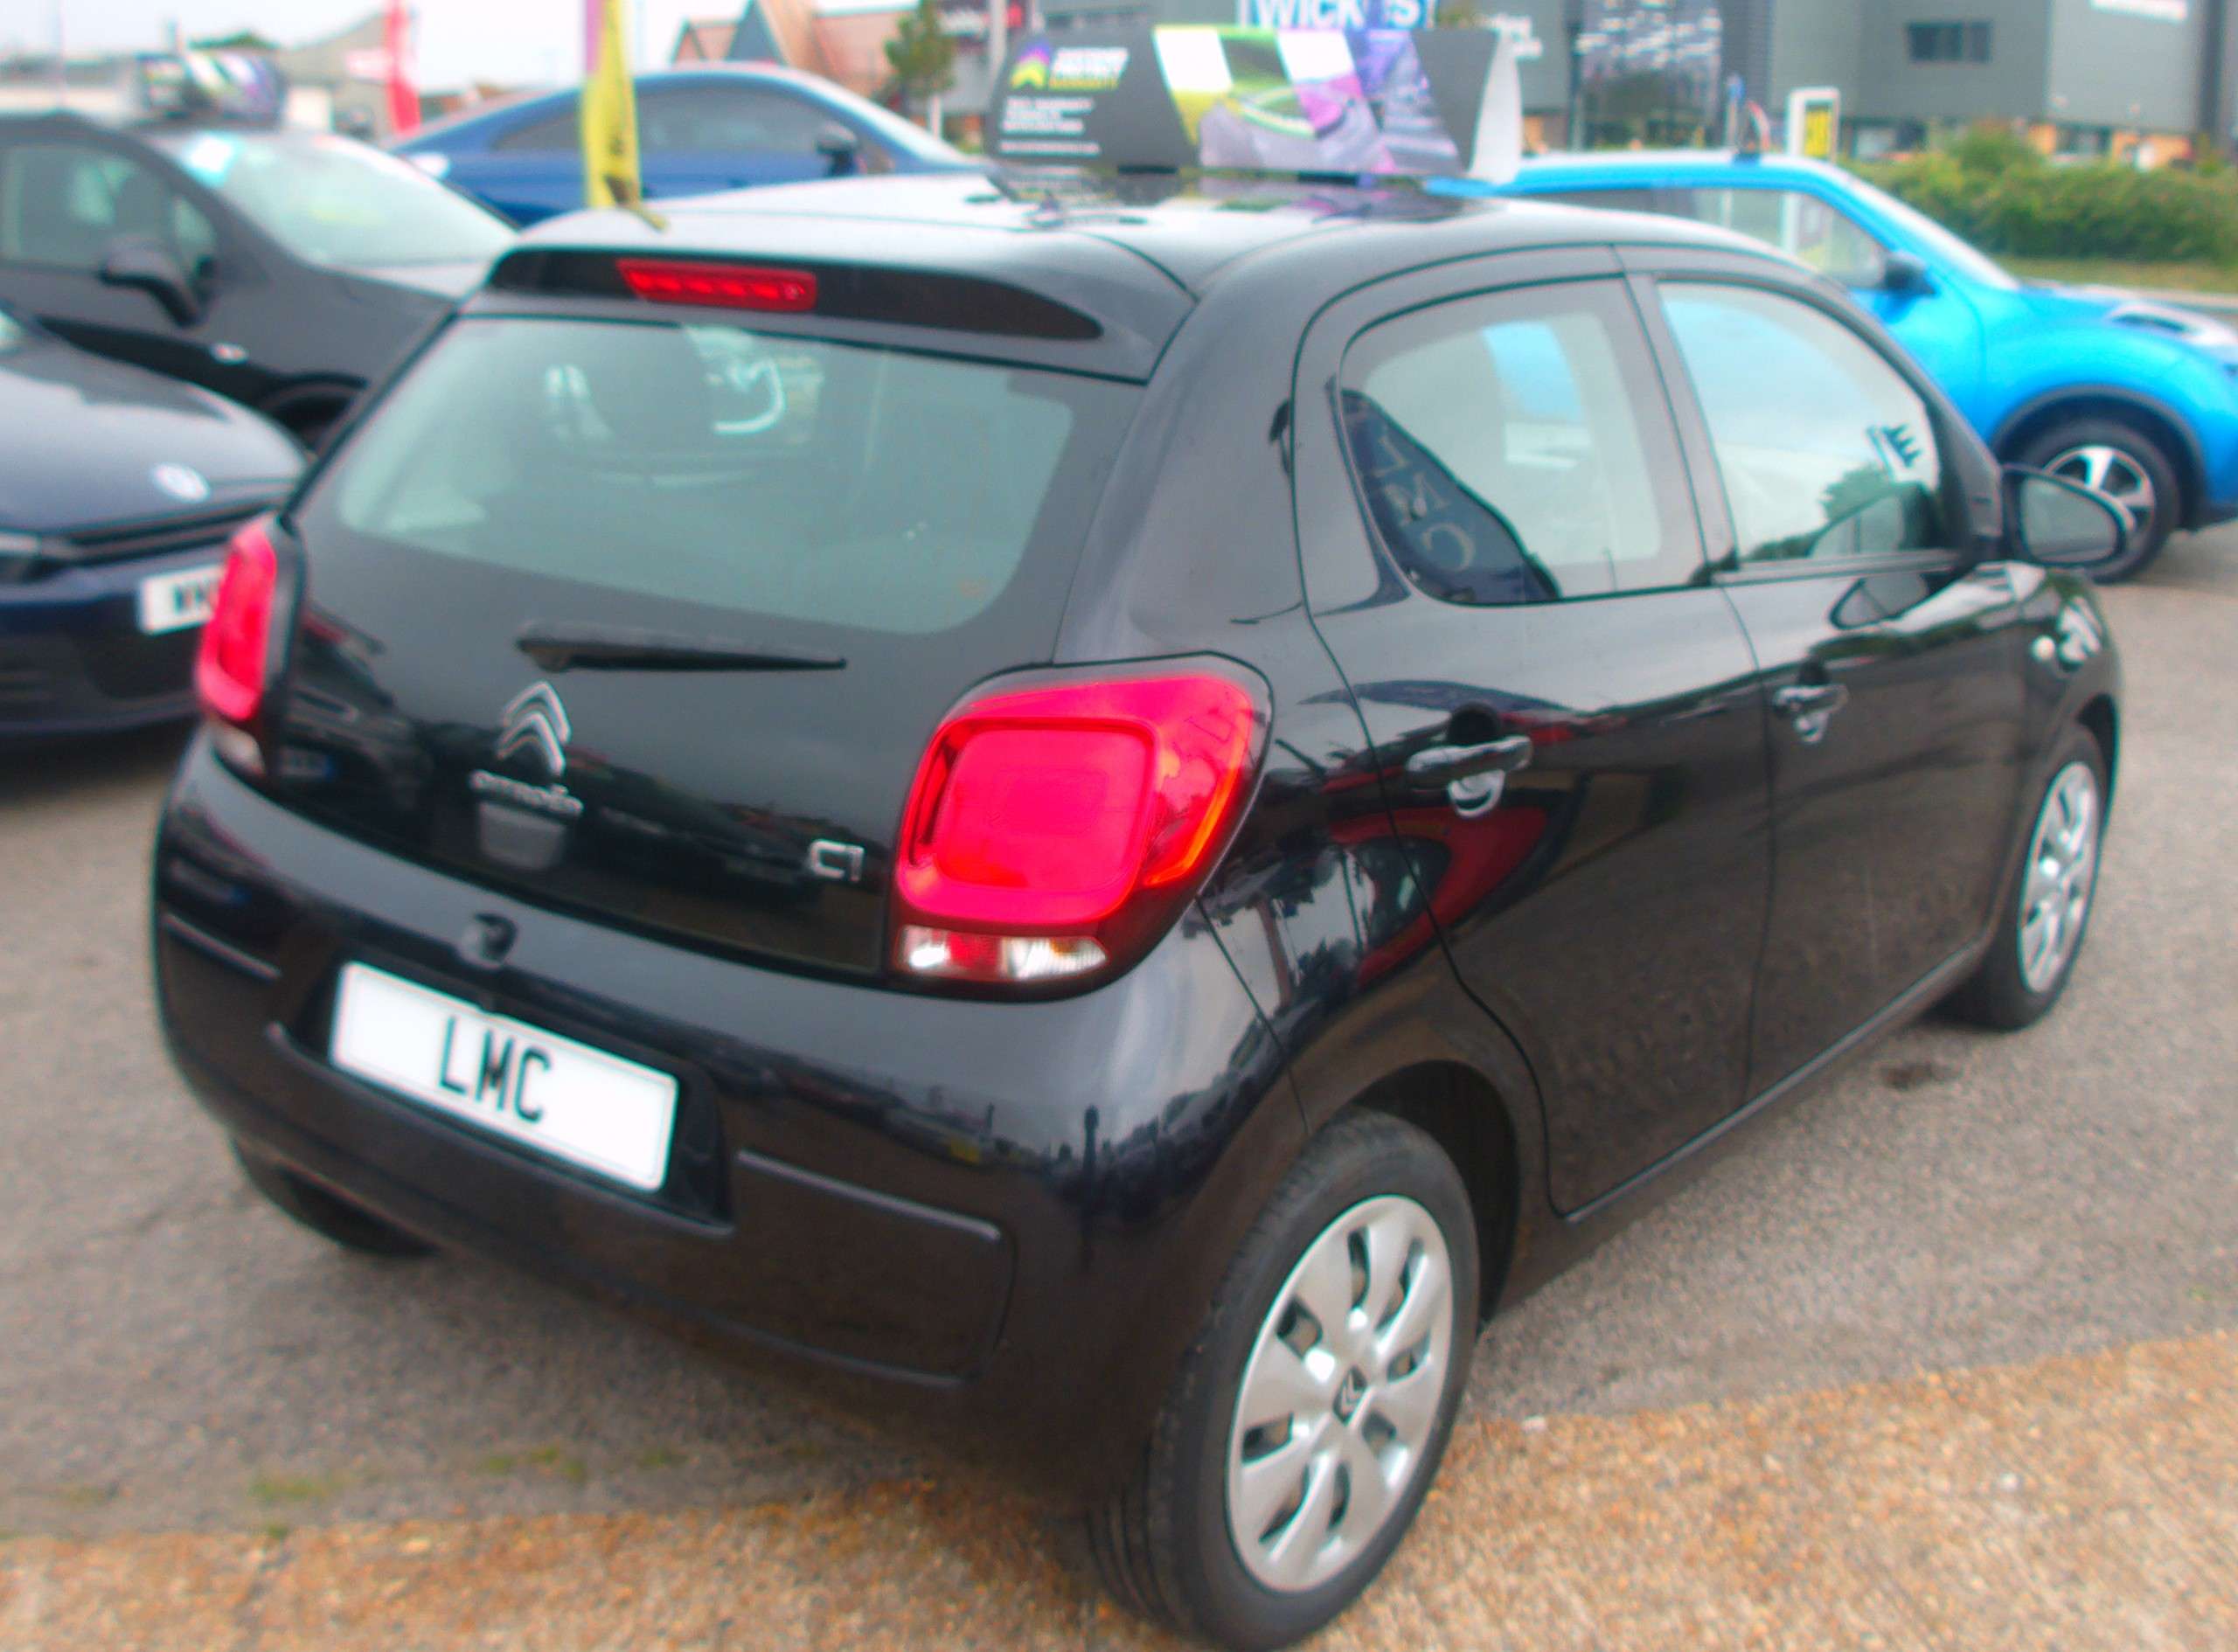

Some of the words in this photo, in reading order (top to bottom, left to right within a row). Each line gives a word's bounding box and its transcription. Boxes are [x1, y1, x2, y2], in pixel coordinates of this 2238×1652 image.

[1255, 0, 1421, 29] WICKS
[809, 840, 865, 882] C1
[439, 1015, 553, 1125] LMC
